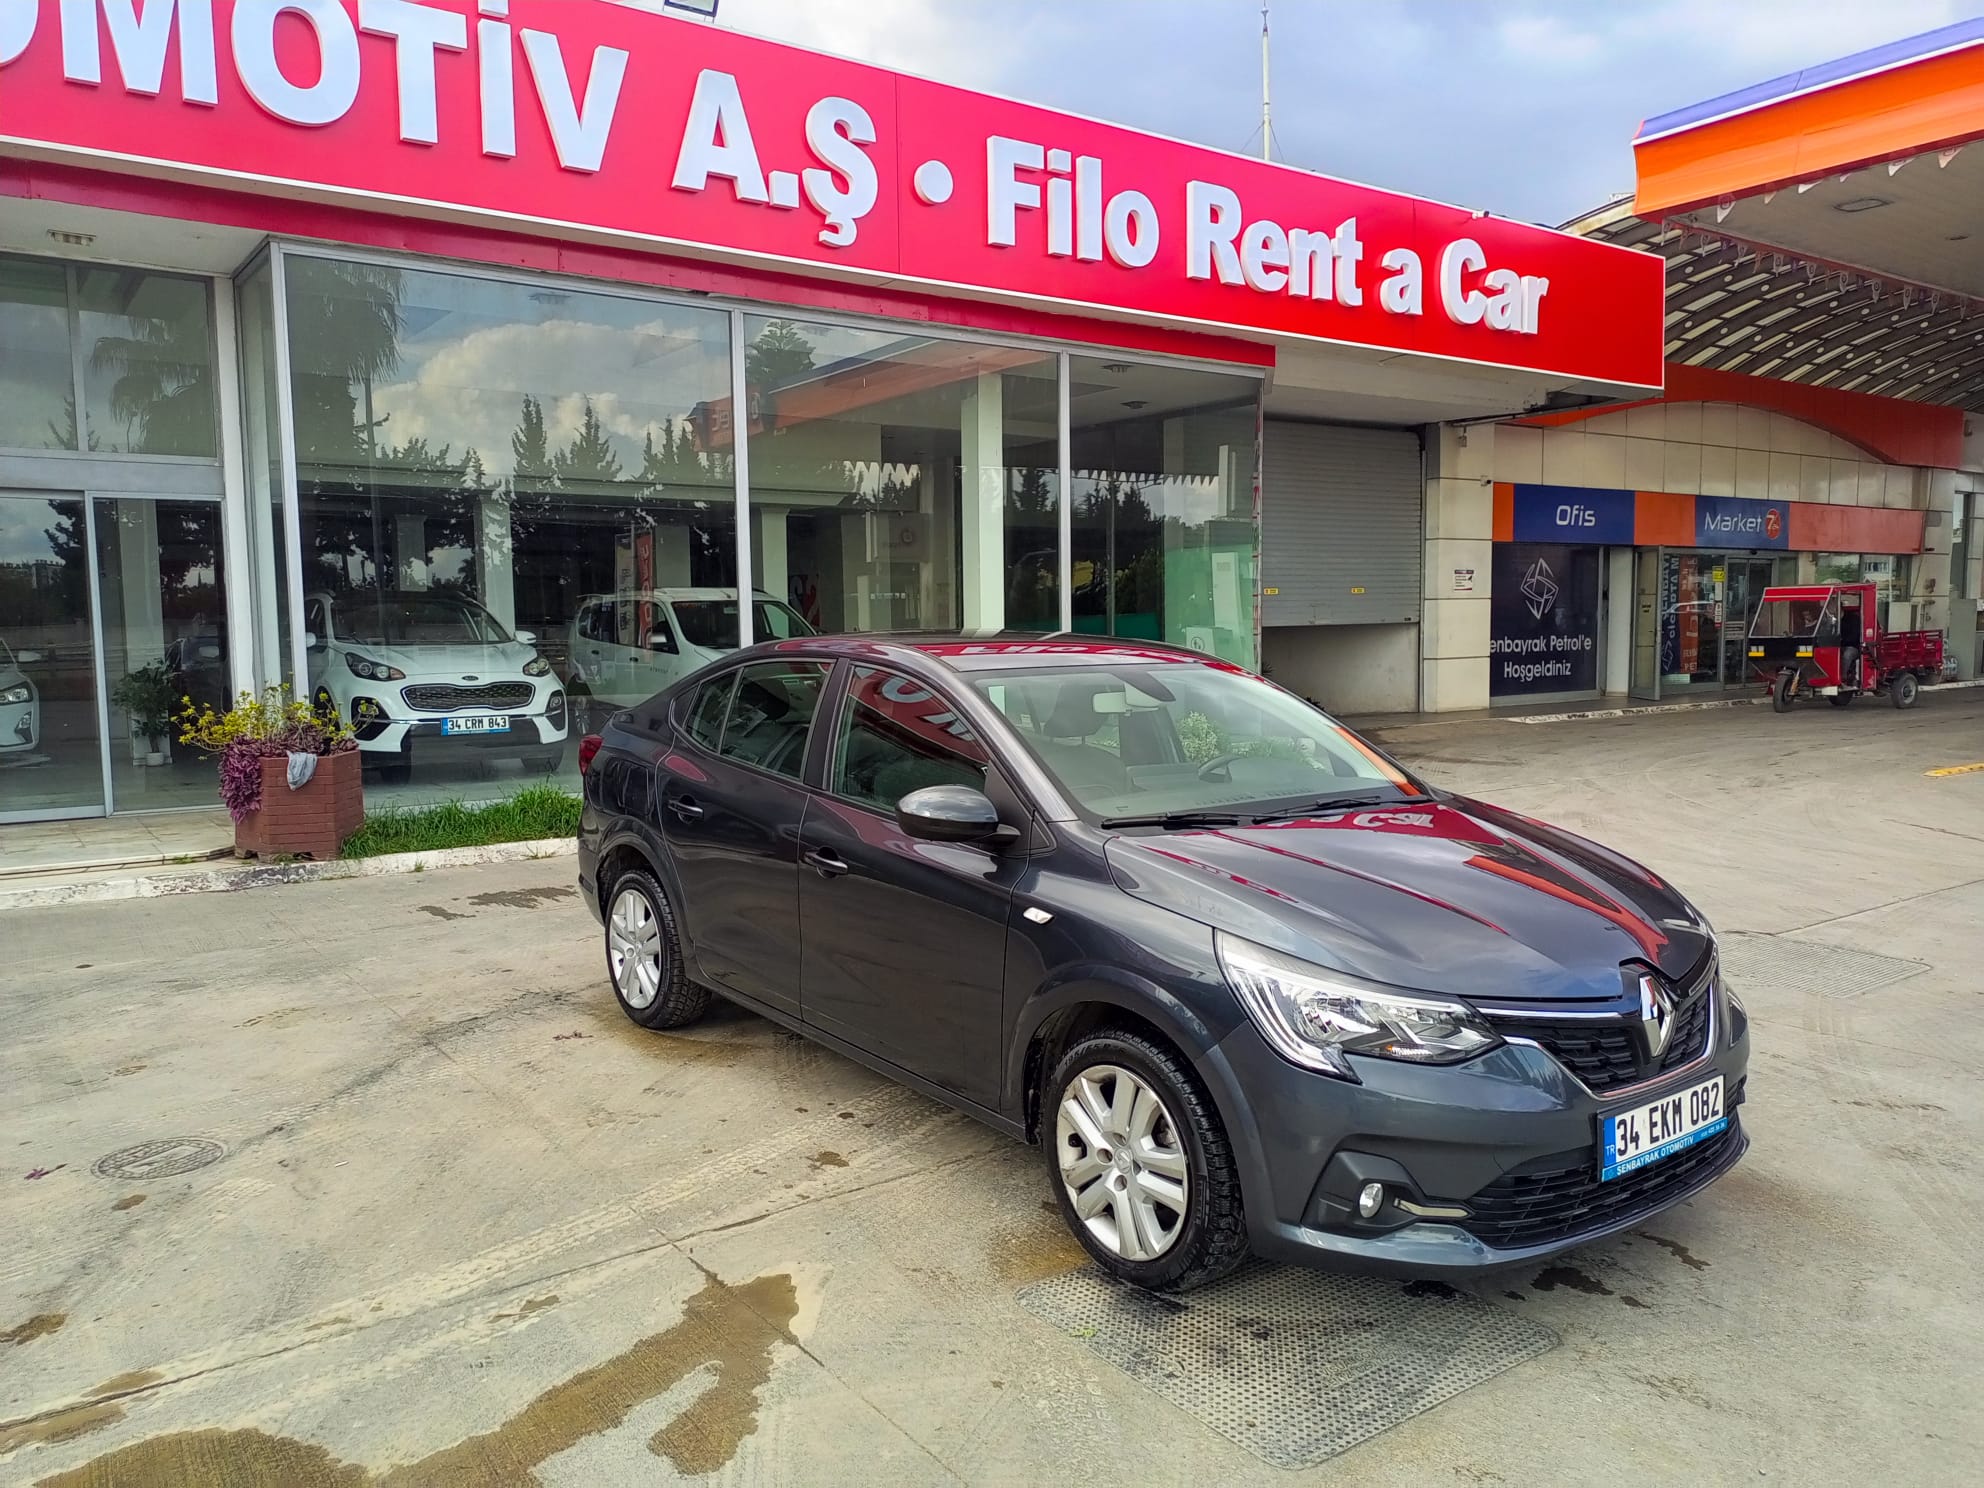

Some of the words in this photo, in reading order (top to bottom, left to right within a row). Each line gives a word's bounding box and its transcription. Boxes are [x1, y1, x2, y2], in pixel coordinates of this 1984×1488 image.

[0, 0, 629, 173] MOTİV
[671, 68, 878, 247] A.Ş
[987, 135, 1159, 268] Filo
[1187, 180, 1363, 307] Rent
[1380, 248, 1423, 316] a
[1440, 238, 1549, 335] Car
[1556, 505, 1596, 527] Ofis
[1704, 512, 1762, 532] Market
[1490, 636, 1547, 656] enbayrak
[1550, 634, 1592, 651] Petrol'e
[1504, 660, 1571, 682] Hoşgeldiniz
[449, 719, 461, 730] 34
[465, 719, 484, 730] CRM
[488, 717, 507, 729] 843
[1616, 1115, 1640, 1156] 34
[1649, 1097, 1682, 1145] EKM
[1690, 1082, 1720, 1126] 082
[1605, 1144, 1616, 1157] TR
